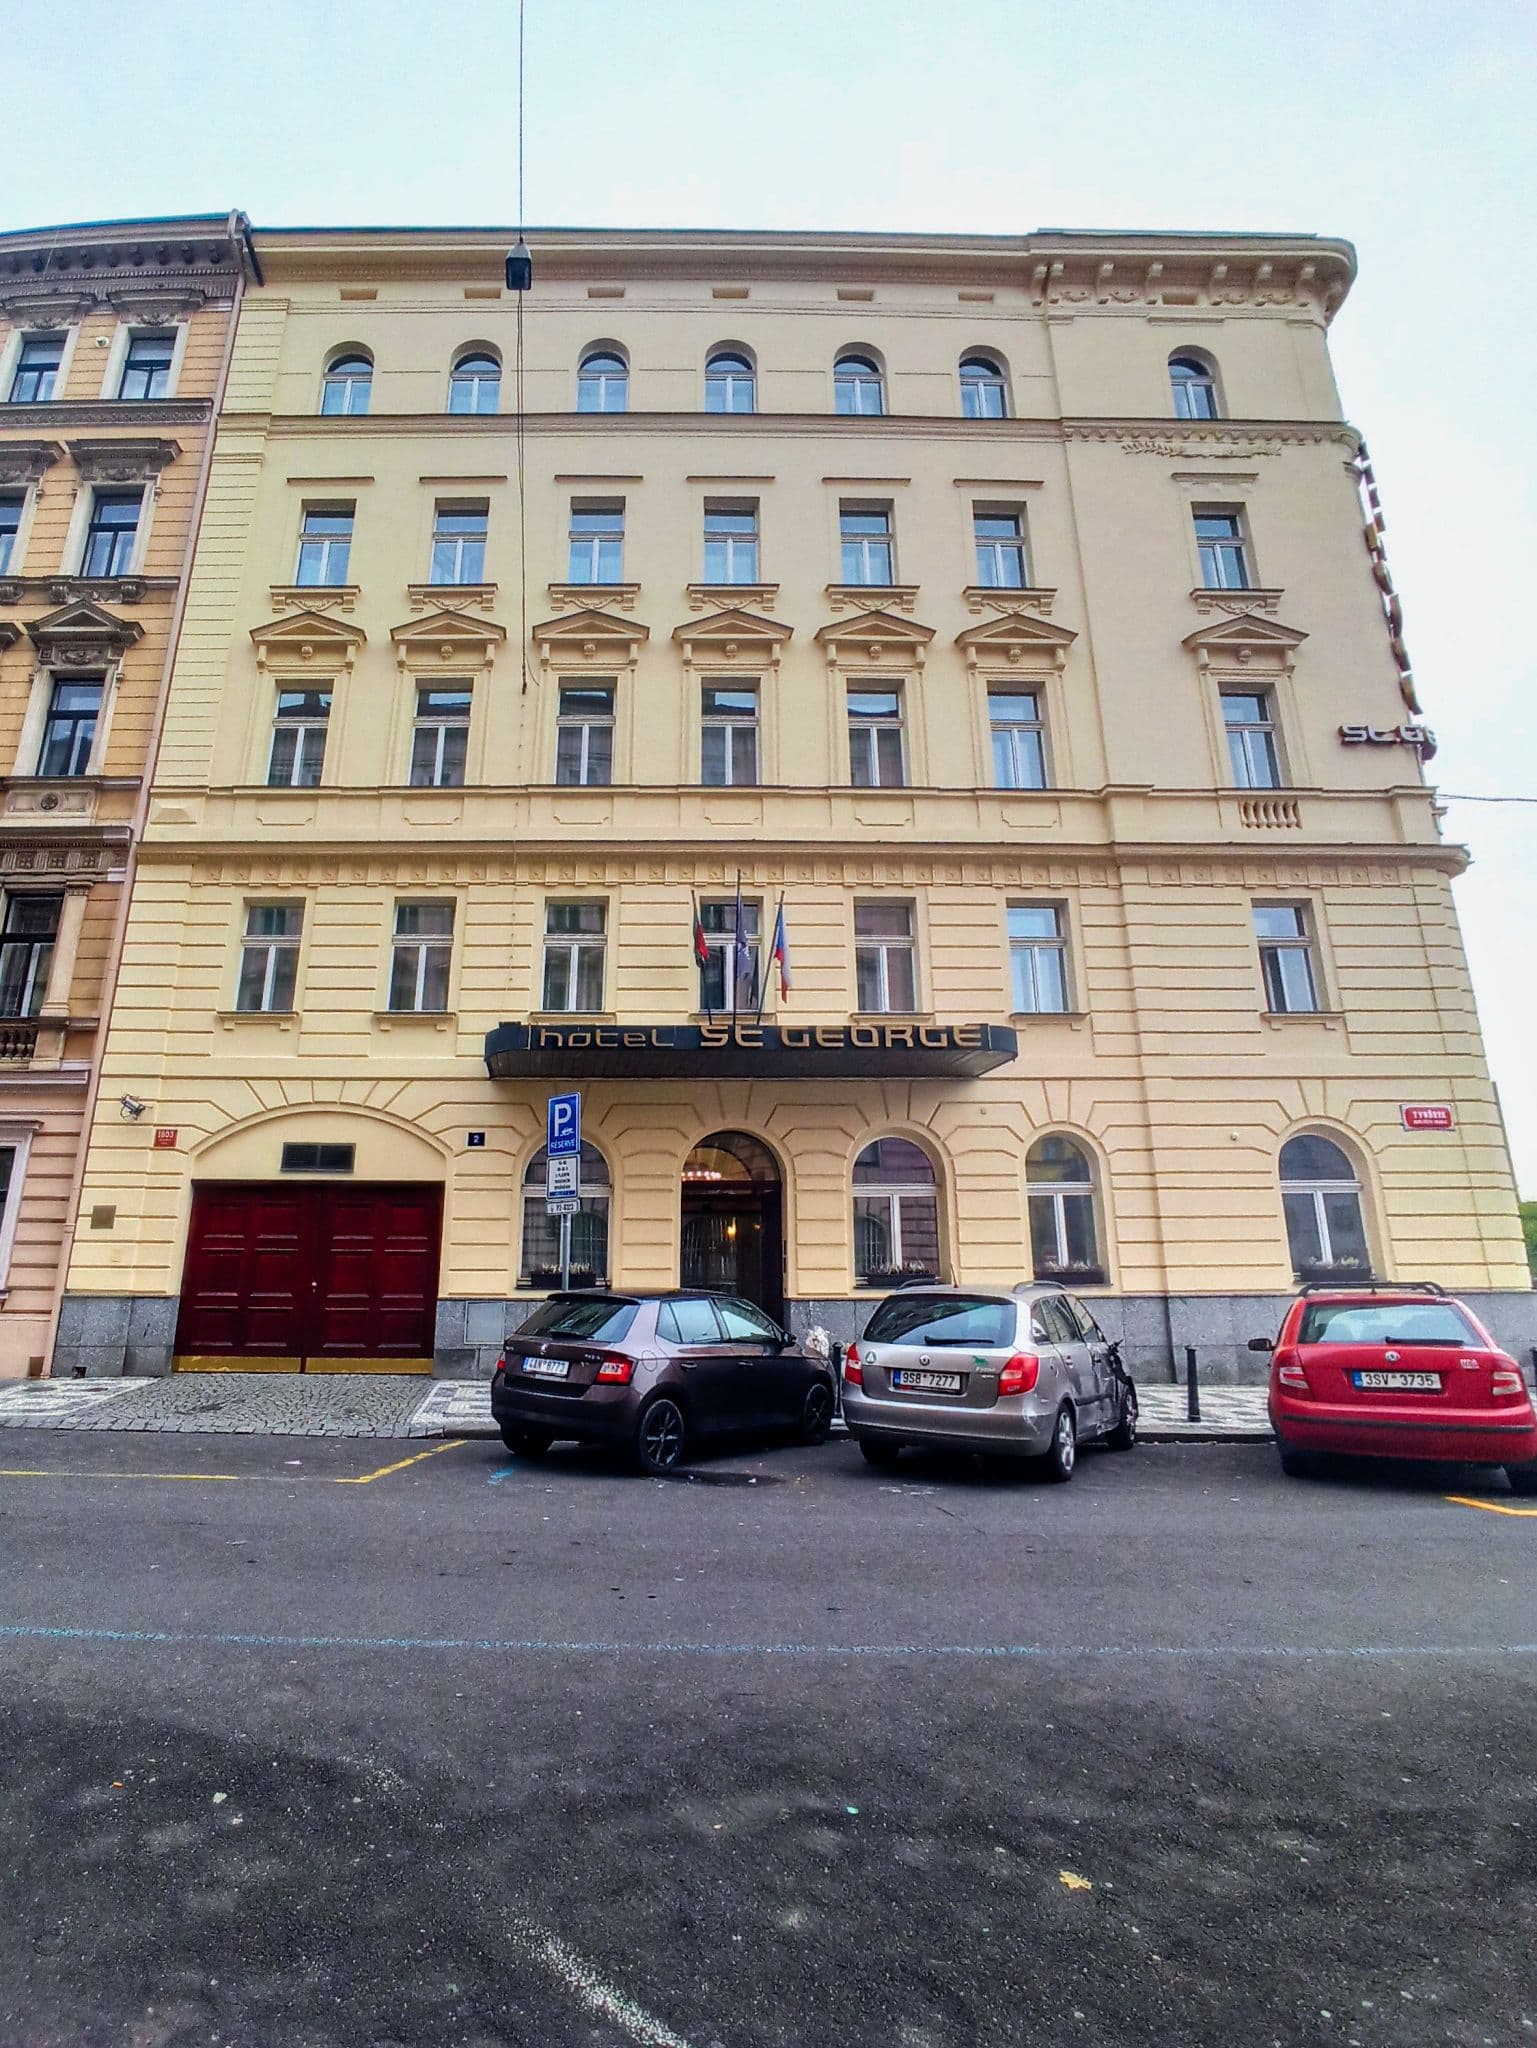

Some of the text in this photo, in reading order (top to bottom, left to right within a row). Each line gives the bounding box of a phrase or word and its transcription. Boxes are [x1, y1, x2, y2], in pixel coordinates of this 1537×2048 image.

[540, 1029, 674, 1047] hotel
[781, 1025, 982, 1047] GEORGE
[555, 1103, 572, 1137] P
[473, 1134, 480, 1144] 2
[902, 1372, 955, 1387] 9S8 7277
[1365, 1373, 1433, 1386] 3SV 3735
